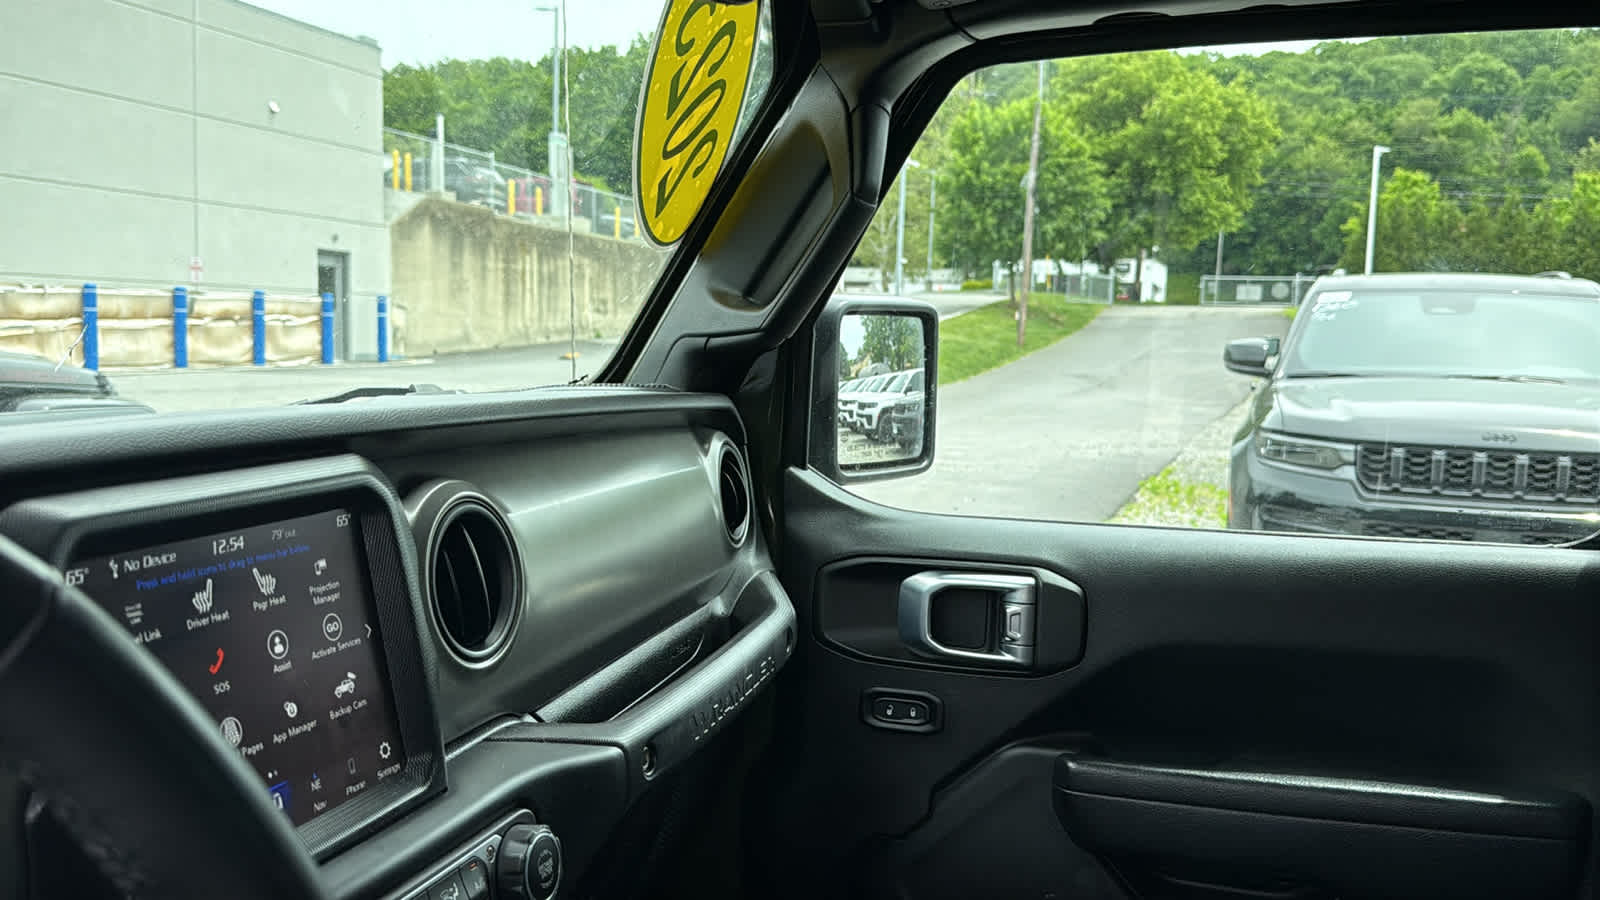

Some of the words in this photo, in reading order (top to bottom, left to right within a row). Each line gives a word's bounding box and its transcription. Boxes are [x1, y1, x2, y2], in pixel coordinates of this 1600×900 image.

[212, 535, 245, 556] 12:54
[123, 559, 140, 572] No
[143, 552, 177, 568] Device
[309, 580, 341, 596] Projection
[269, 593, 287, 605] Heat
[313, 591, 341, 606] Manager
[186, 617, 209, 630] Driver
[210, 609, 230, 623] Heat
[326, 621, 340, 633] GO
[311, 646, 336, 660] Activate
[337, 637, 362, 651] Services
[213, 680, 231, 695] SOS
[329, 704, 352, 720] Backup
[352, 699, 368, 710] Cam
[272, 731, 287, 745] App
[287, 719, 317, 737] Manager
[241, 742, 264, 757] Pages
[310, 778, 322, 791] NE
[345, 780, 366, 796] Phone
